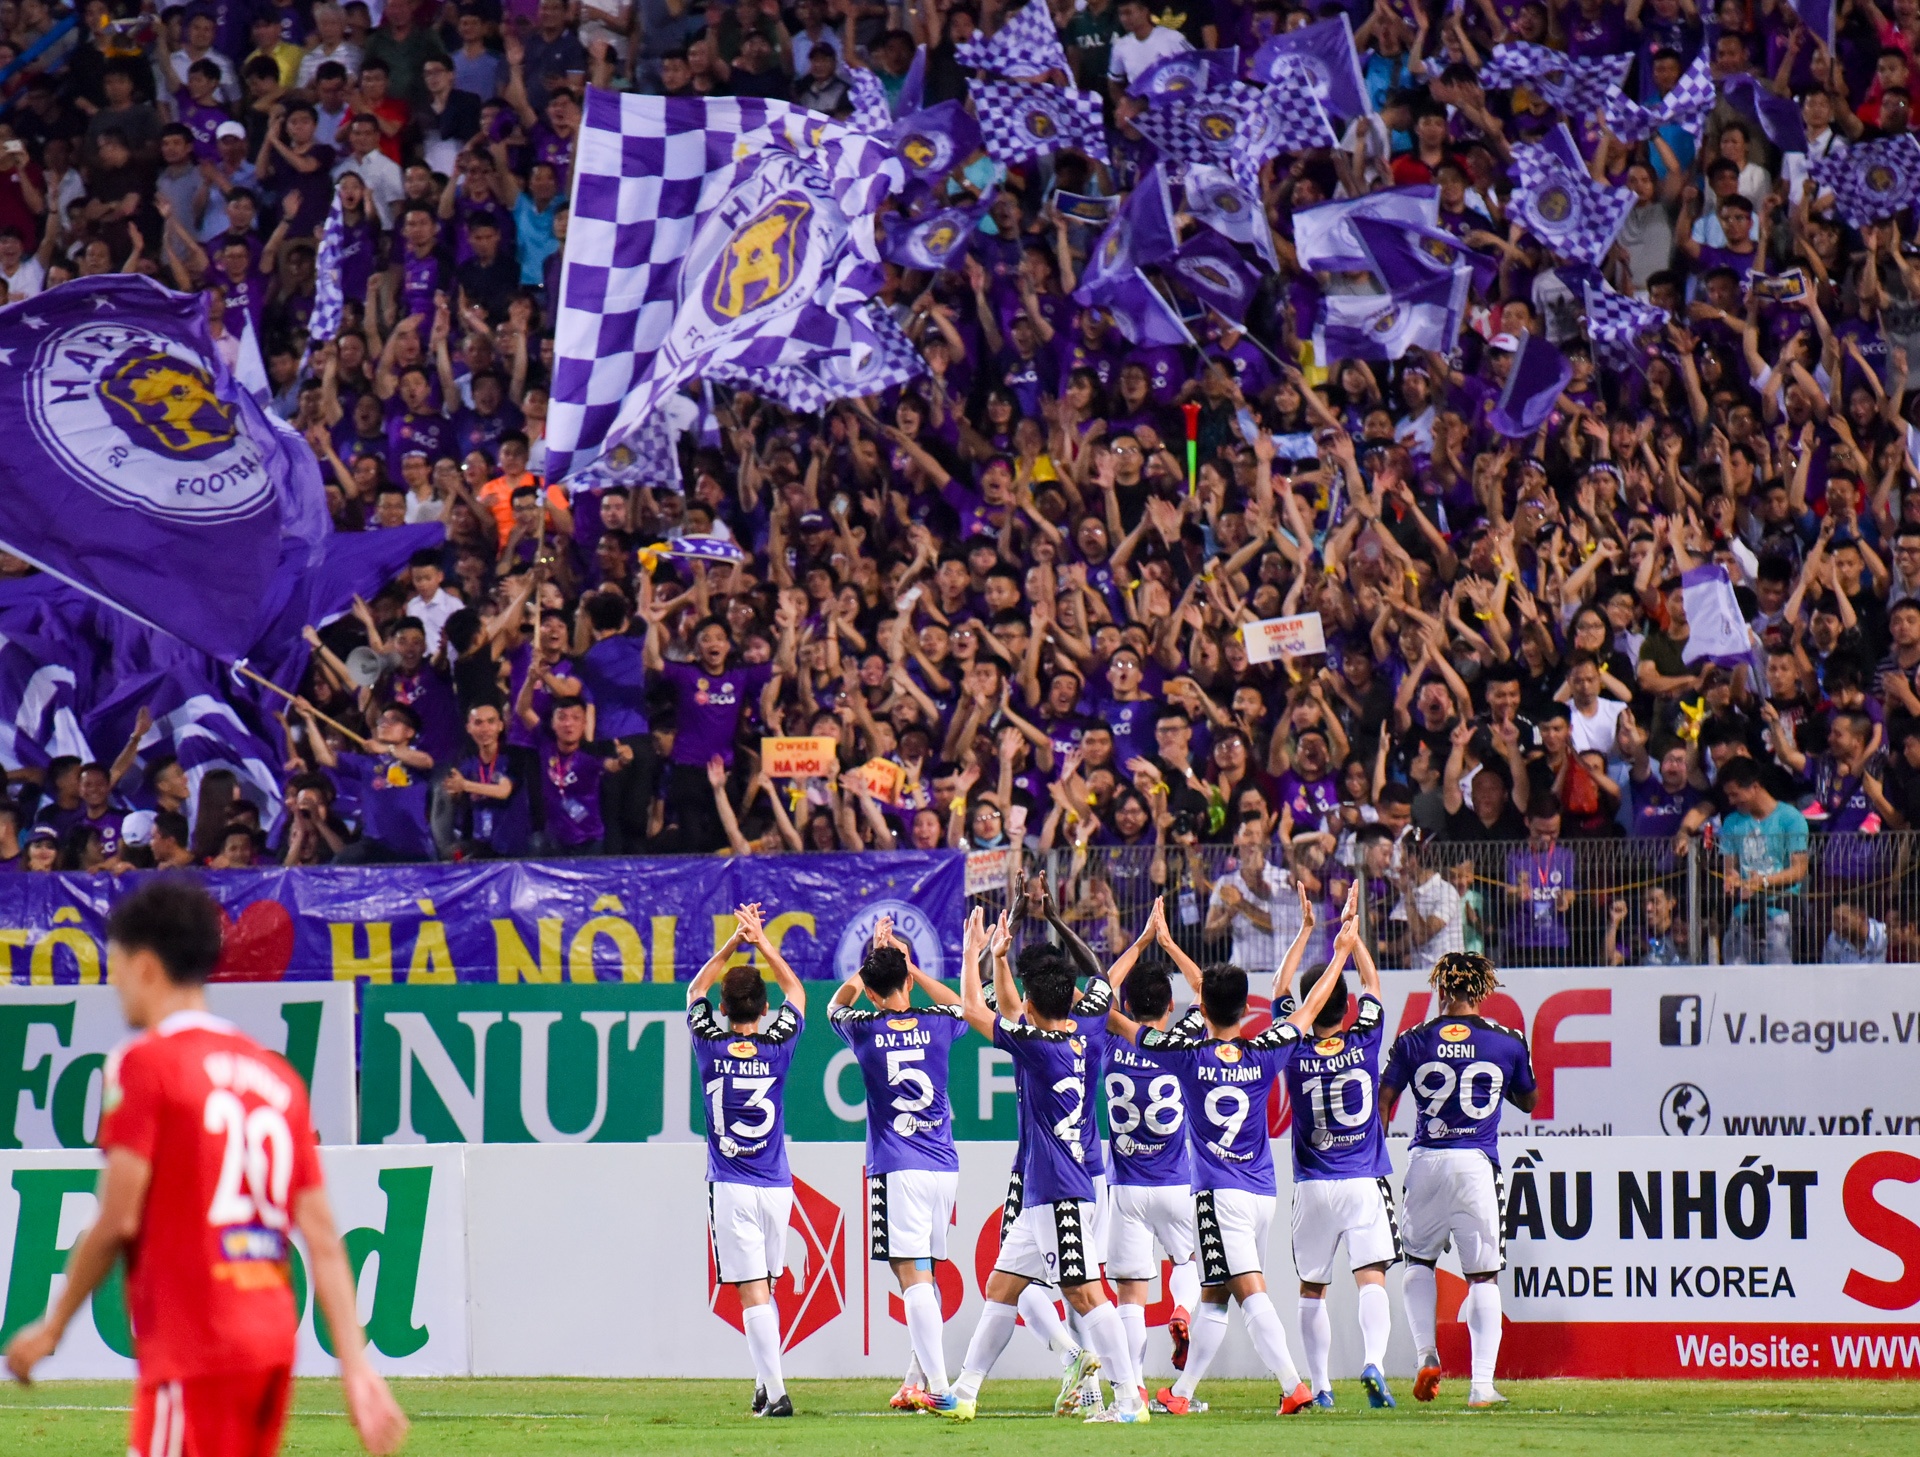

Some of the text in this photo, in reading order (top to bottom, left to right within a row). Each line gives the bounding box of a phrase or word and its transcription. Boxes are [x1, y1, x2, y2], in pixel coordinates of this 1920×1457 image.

[328, 898, 457, 985] HÀ
[903, 1031, 931, 1050] HẬU
[1436, 1044, 1476, 1059] OSENI
[1723, 1012, 1920, 1054] V.league.V
[713, 1059, 770, 1076] T.V. KIÊN
[886, 1048, 934, 1112] 5
[1197, 1064, 1262, 1083] P.V. THÀNH
[1300, 1059, 1324, 1073] N.V.
[1413, 1061, 1505, 1120] 90
[706, 1076, 778, 1139] 13
[1105, 1072, 1185, 1136] 88
[1203, 1085, 1251, 1148] 9
[1302, 1068, 1373, 1130] 10
[204, 1088, 297, 1228] 20
[1314, 1130, 1366, 1151] Artexport
[1618, 1155, 1819, 1241] NHỚT
[1513, 1265, 1797, 1299] MADE IN KOREA
[1675, 1334, 1820, 1369] Website:
